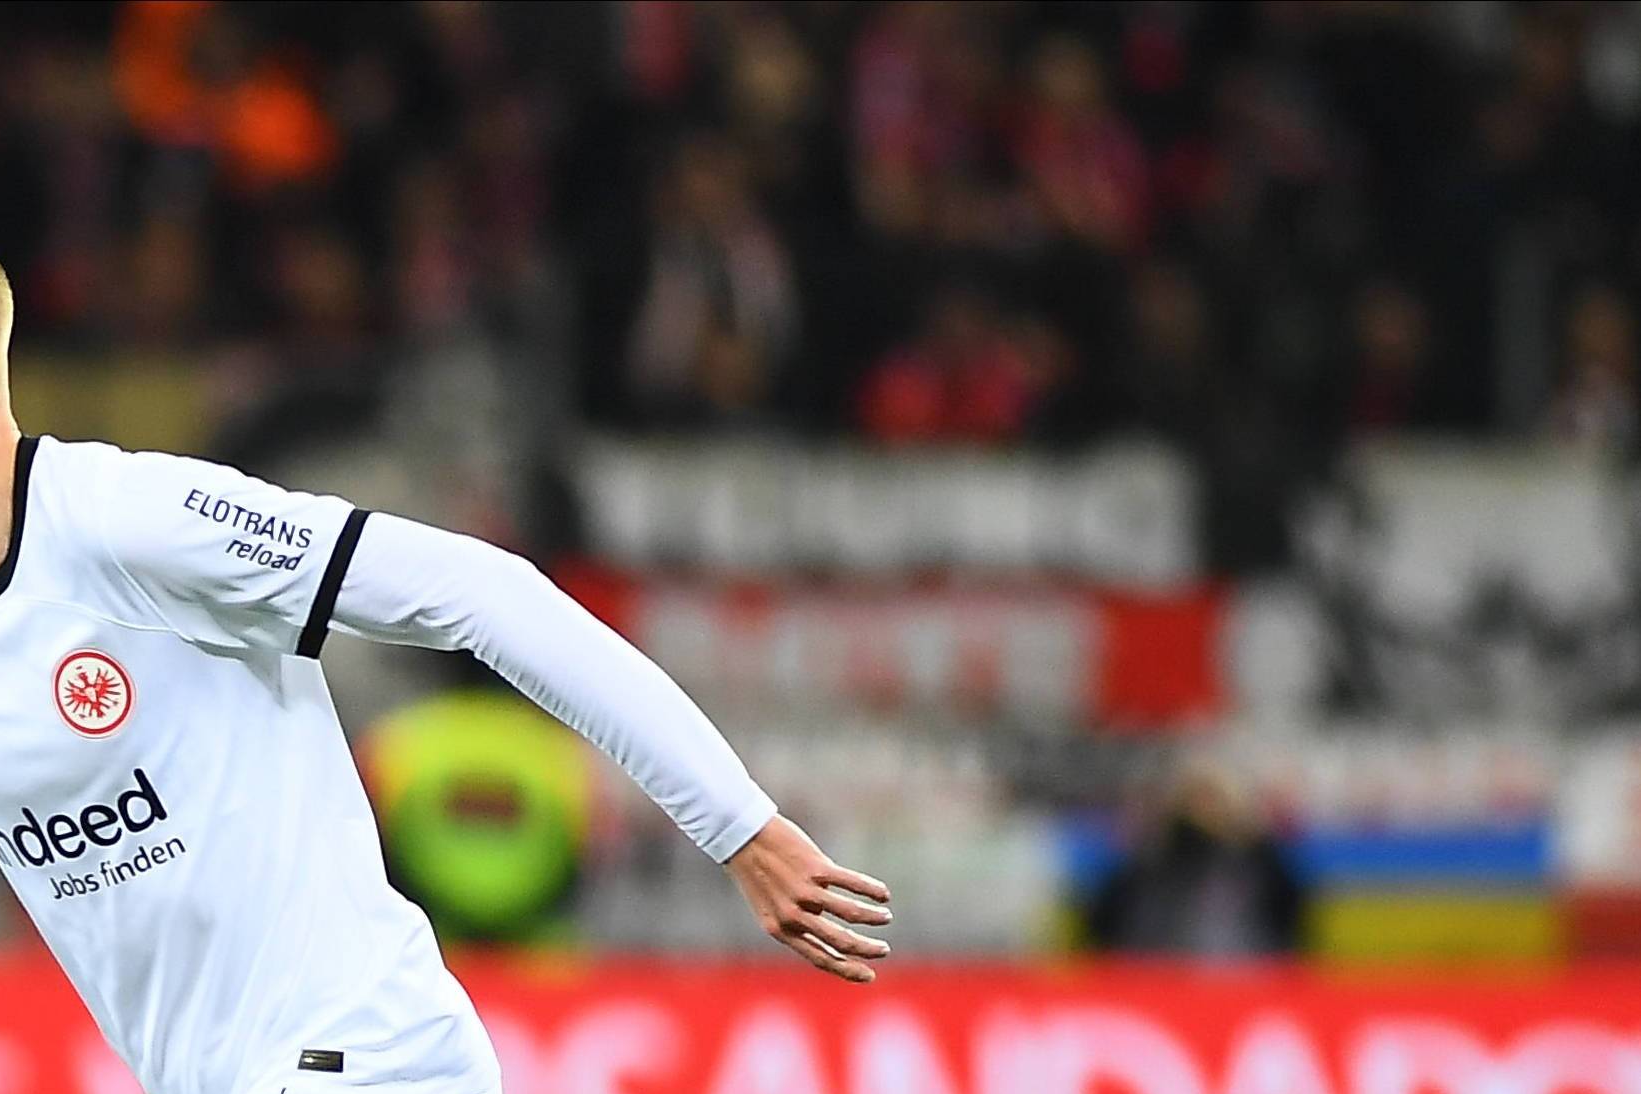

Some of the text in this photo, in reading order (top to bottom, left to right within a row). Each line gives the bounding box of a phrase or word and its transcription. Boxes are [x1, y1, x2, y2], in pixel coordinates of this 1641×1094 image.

[183, 488, 313, 549] ELOTRANS
[225, 538, 305, 571] reload
[50, 836, 187, 900] Jobs finden
